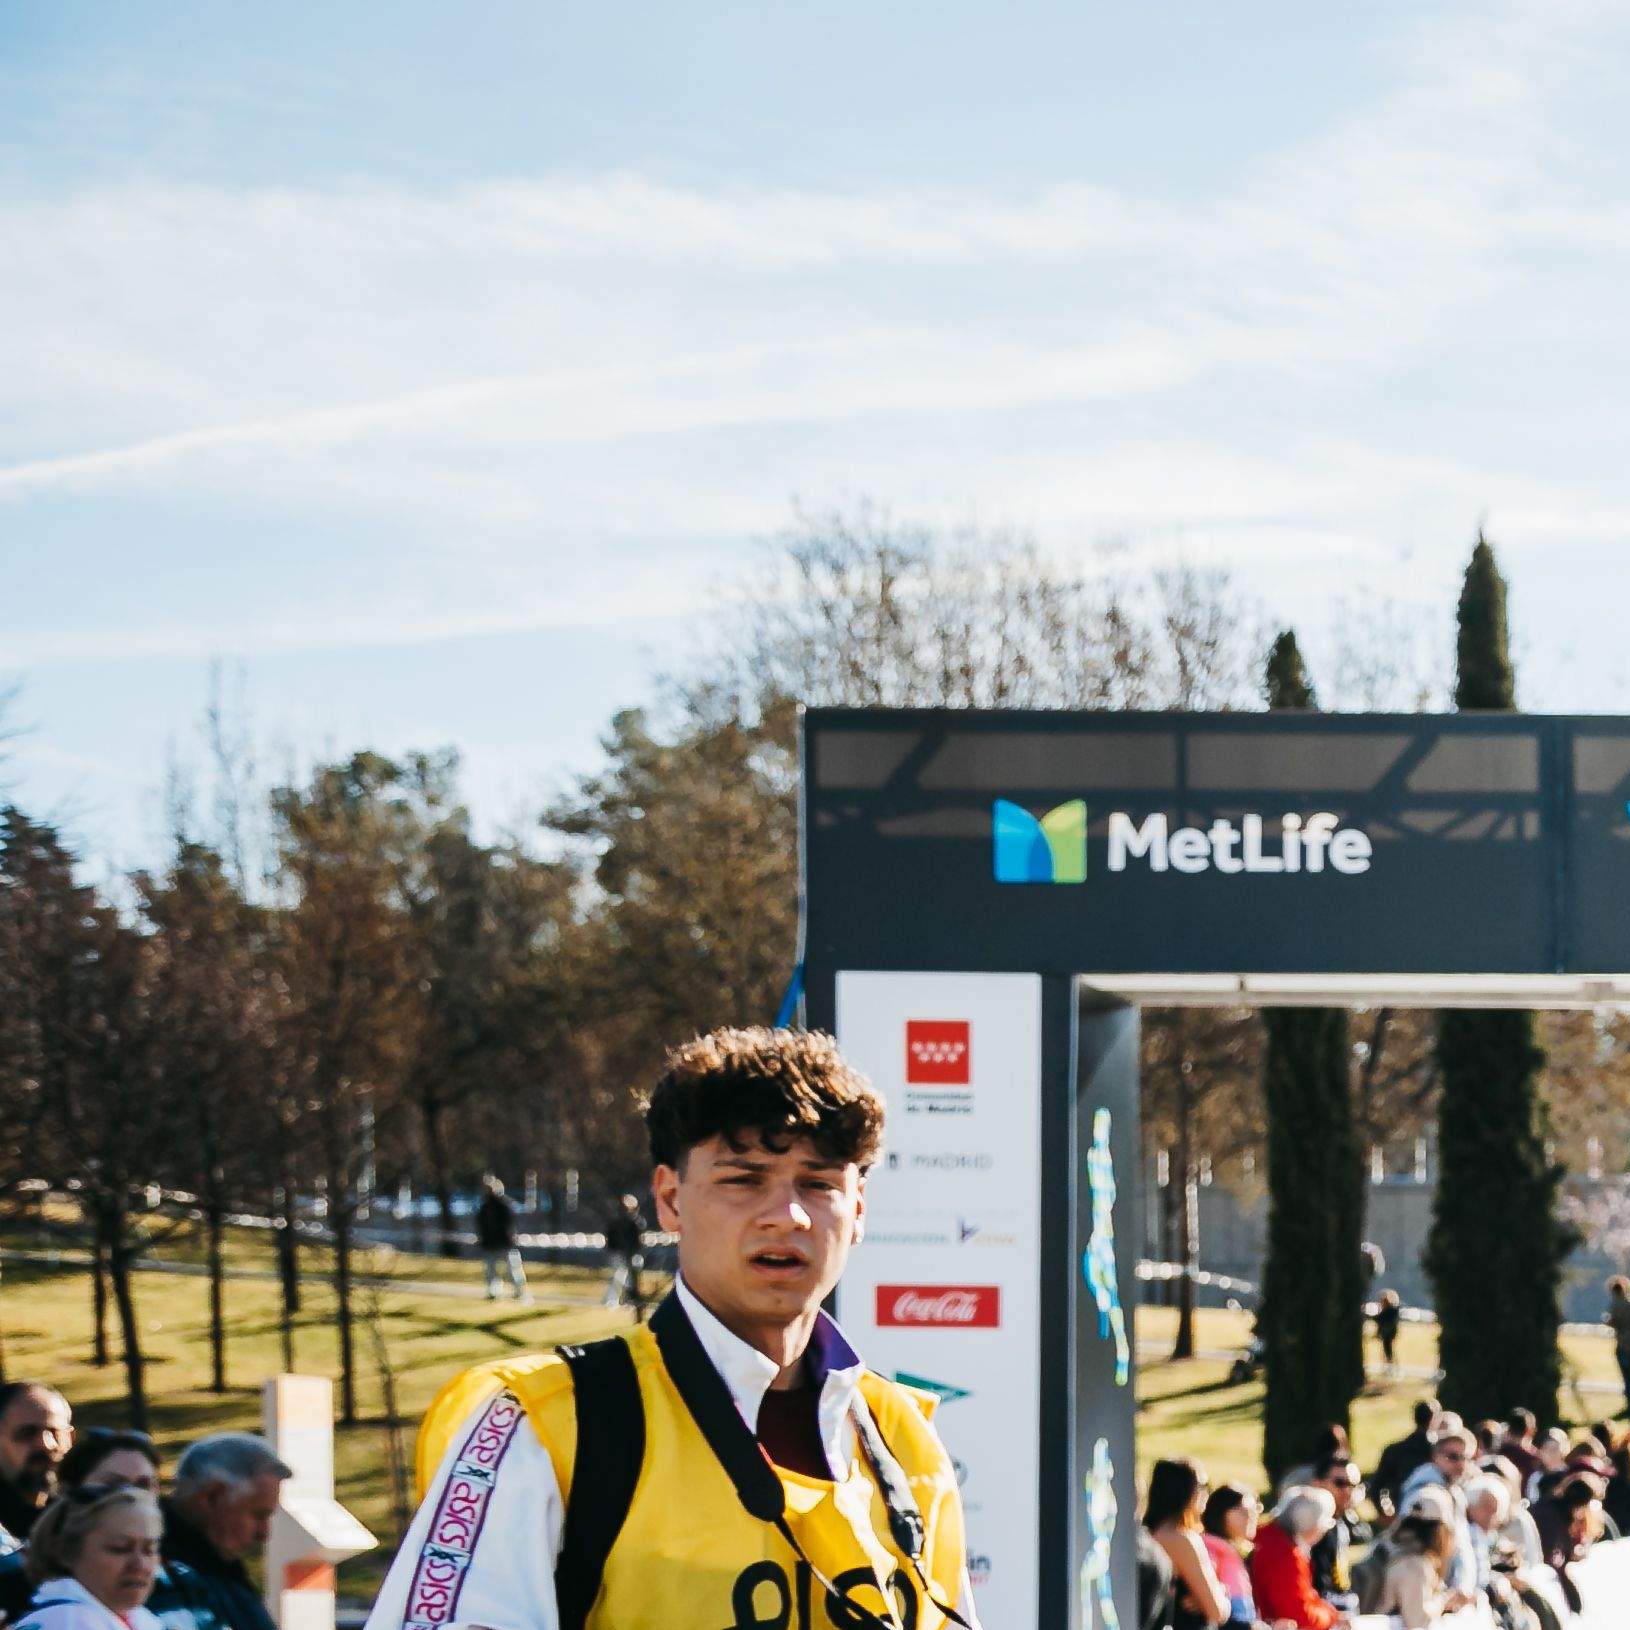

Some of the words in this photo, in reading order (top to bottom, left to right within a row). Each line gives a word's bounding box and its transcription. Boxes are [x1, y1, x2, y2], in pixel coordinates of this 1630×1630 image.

[1108, 811, 1372, 875] MetLife
[468, 1403, 516, 1465] asics
[438, 1481, 481, 1549] asics
[416, 1558, 457, 1623] asics
